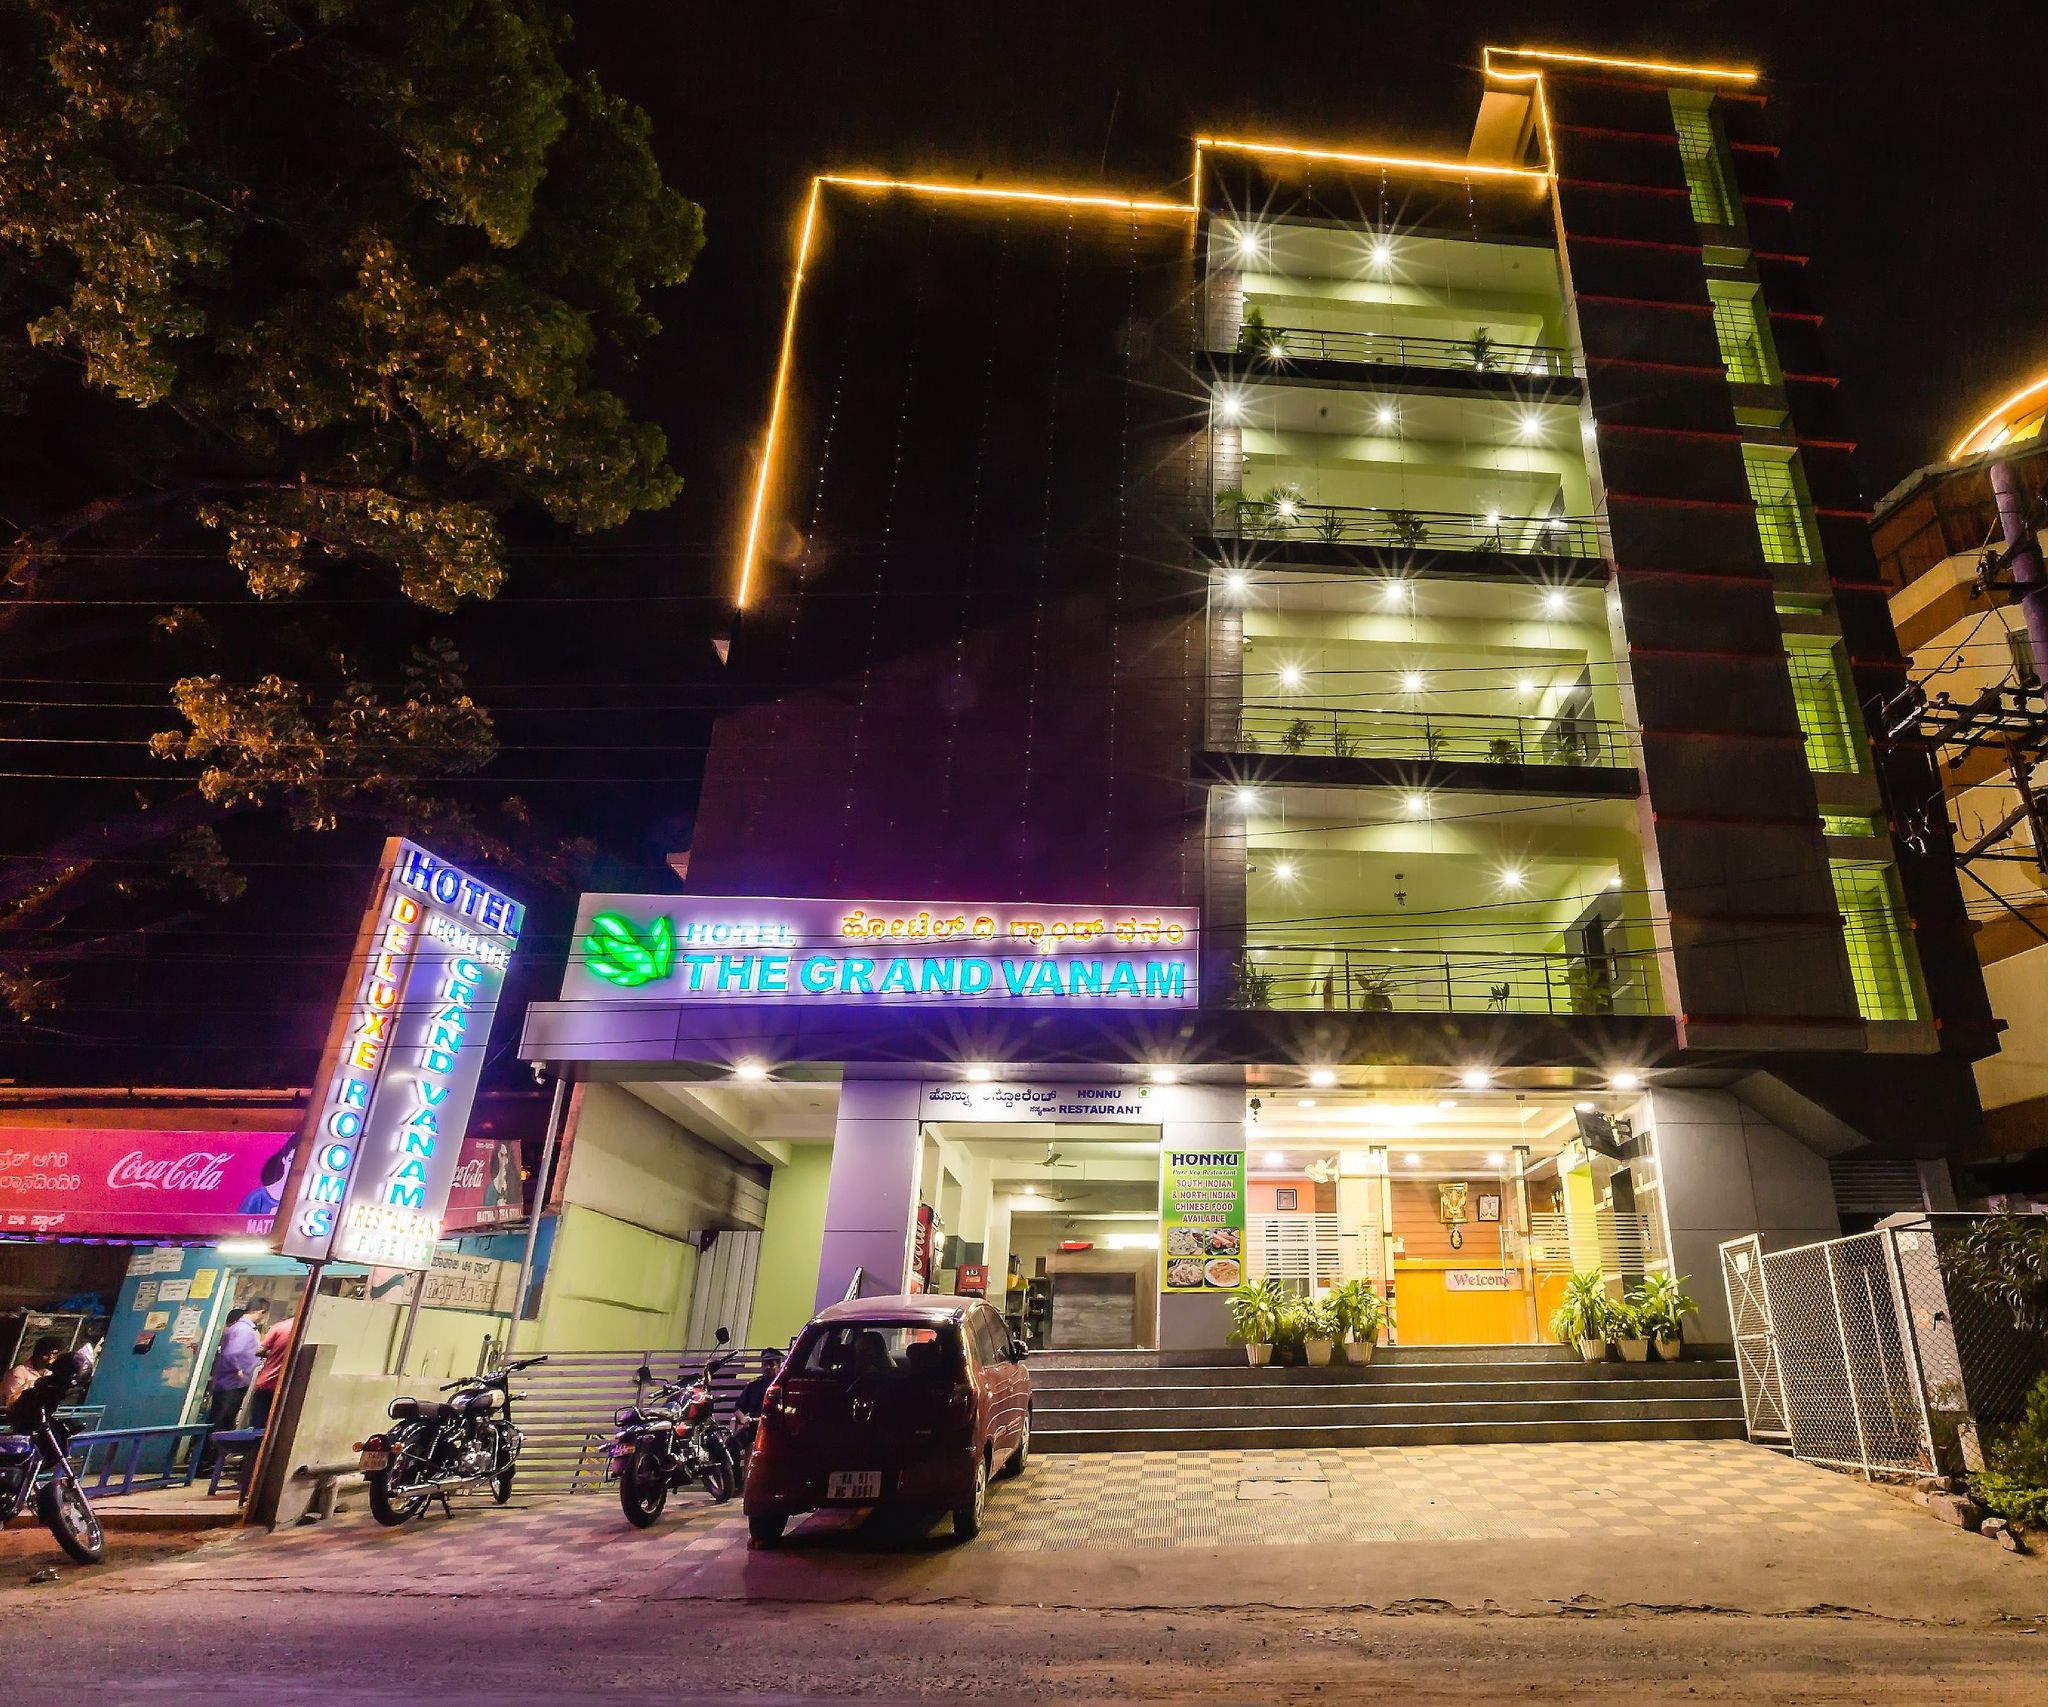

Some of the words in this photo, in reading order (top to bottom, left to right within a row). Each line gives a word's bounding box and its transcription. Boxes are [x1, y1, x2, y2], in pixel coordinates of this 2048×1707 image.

[402, 850, 519, 940] HOTEL
[687, 922, 796, 946] HOTEL
[1114, 917, 1185, 944] ವನಂ
[350, 895, 419, 1071] DELUXE
[683, 953, 792, 992] THE
[800, 955, 994, 995] GRAND
[1001, 960, 1186, 998] VANAM
[421, 958, 482, 1074] GRAND
[982, 1089, 1057, 1107] ಸ್ಟೋರೆಂಟ್
[1077, 1089, 1122, 1099] HONNU
[1058, 1105, 1143, 1115] RESTAURANT
[386, 1080, 449, 1209] VANAM
[107, 1151, 236, 1191] Coca-Cola
[302, 1079, 368, 1238] ROOMS
[1172, 1153, 1238, 1166] HONNU
[1176, 1179, 1203, 1188] SOUTH
[1205, 1179, 1232, 1188] INDIAN
[1180, 1191, 1207, 1199] NORTH
[1209, 1191, 1236, 1199] INDIAN
[1175, 1202, 1209, 1211] CHINESE
[1211, 1202, 1233, 1211] FOOD
[1183, 1214, 1225, 1223] AVAILABLE
[349, 1204, 443, 1241] RESTAURAN
